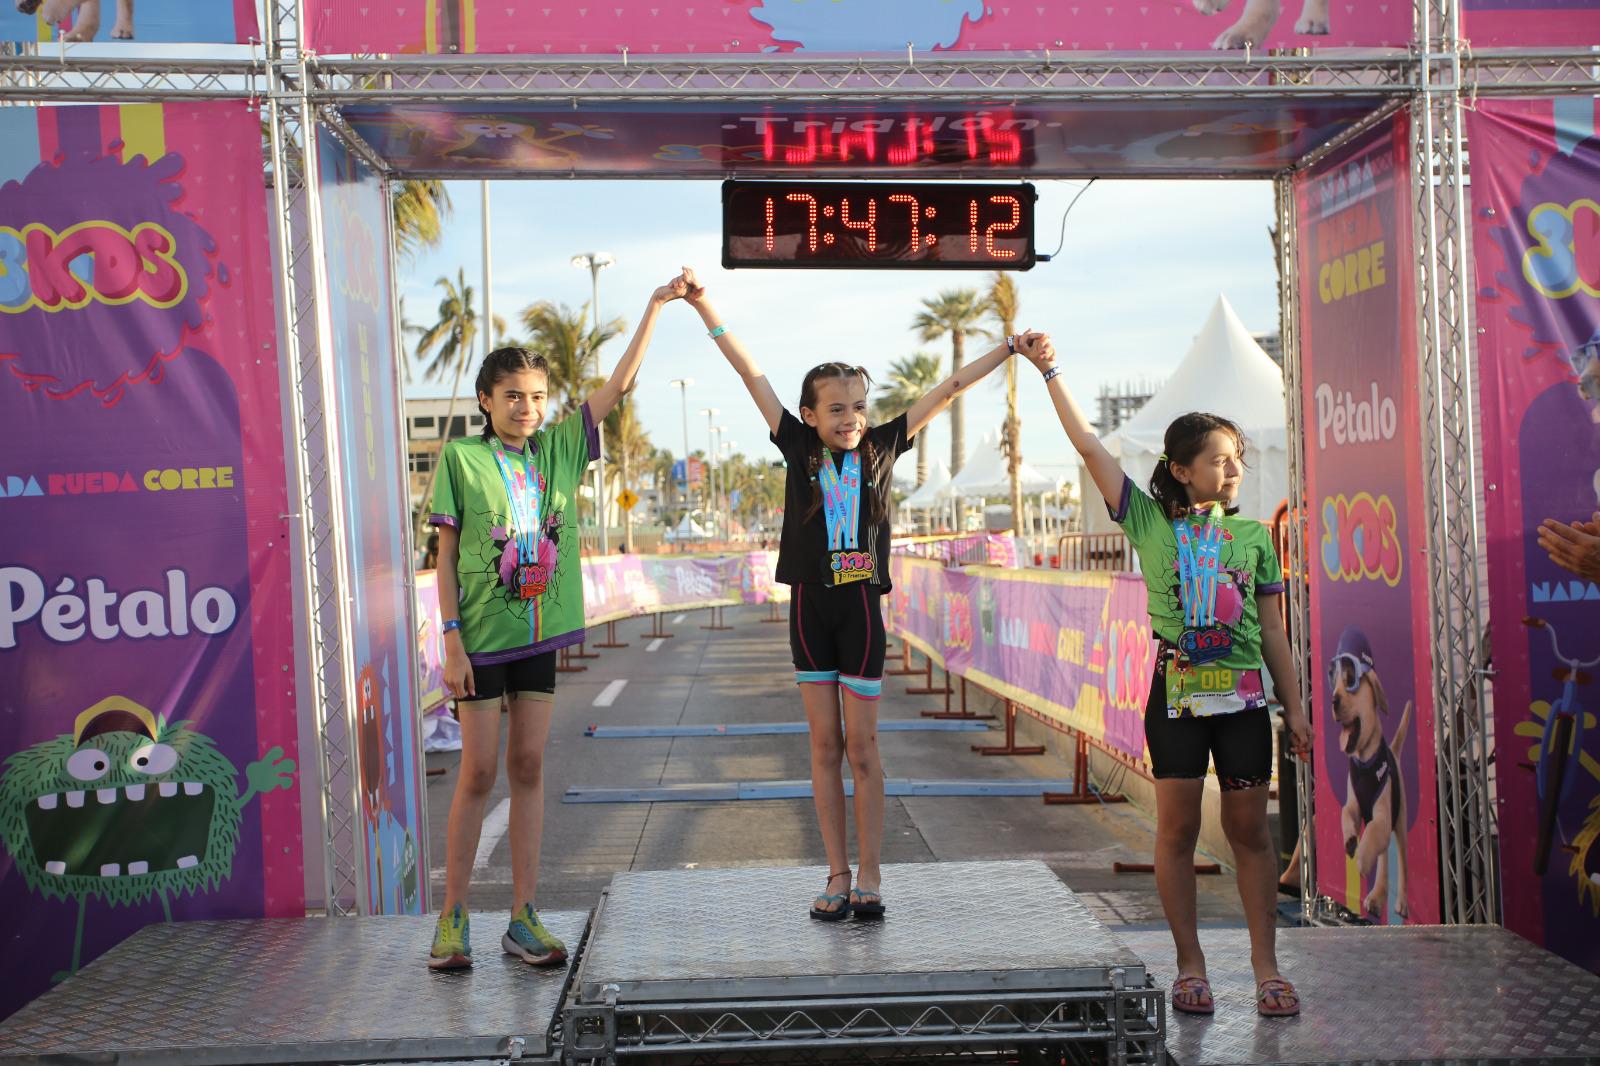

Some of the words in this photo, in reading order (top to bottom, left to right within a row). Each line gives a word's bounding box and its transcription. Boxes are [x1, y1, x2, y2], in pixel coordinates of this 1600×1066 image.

[1320, 156, 1376, 217] NADA
[765, 193, 1020, 258] 17:47:12
[1319, 242, 1386, 304] CORRE
[1316, 381, 1396, 449] Pétalo
[48, 471, 139, 495] RUEDA
[143, 466, 234, 491] CORRE
[0, 566, 236, 648] Pétalo
[1532, 580, 1600, 602] NADA
[1201, 670, 1232, 689] 019
